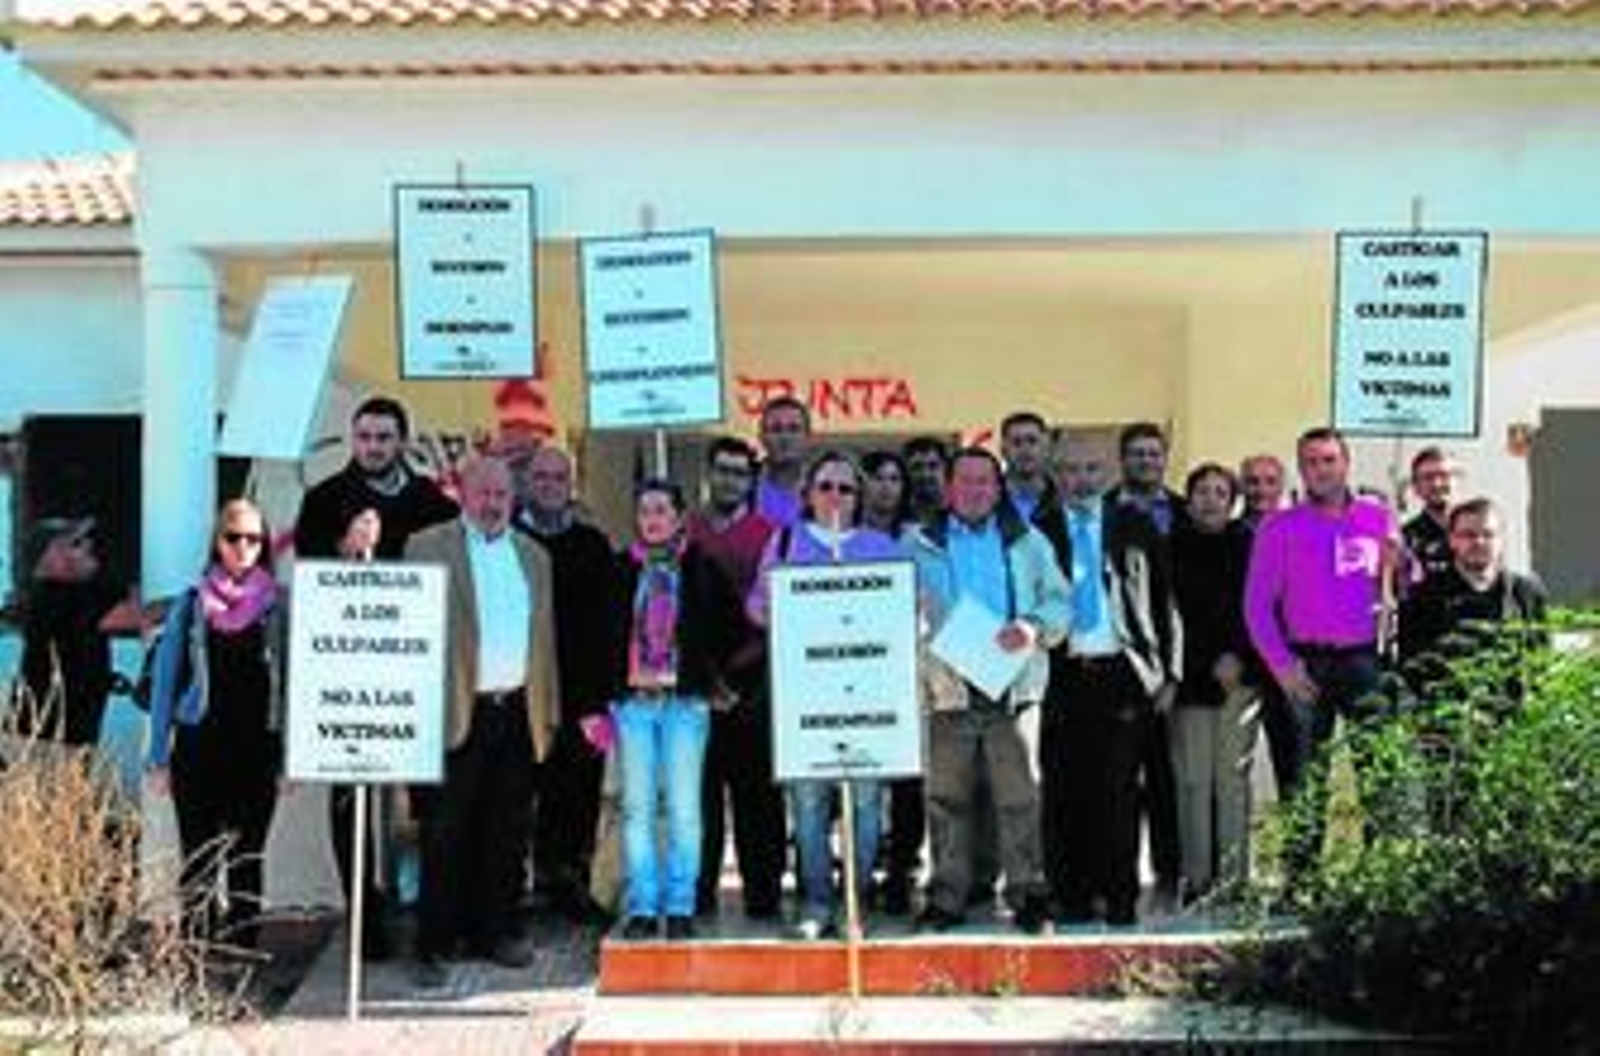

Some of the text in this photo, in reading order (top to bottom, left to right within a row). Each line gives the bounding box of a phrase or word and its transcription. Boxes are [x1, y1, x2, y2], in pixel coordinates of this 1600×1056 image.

[1384, 270, 1440, 289] A LOS
[1364, 351, 1394, 367] NO
[1412, 351, 1450, 367] LAS
[342, 604, 356, 620] A
[319, 689, 352, 706] NO
[374, 690, 415, 706] LAS
